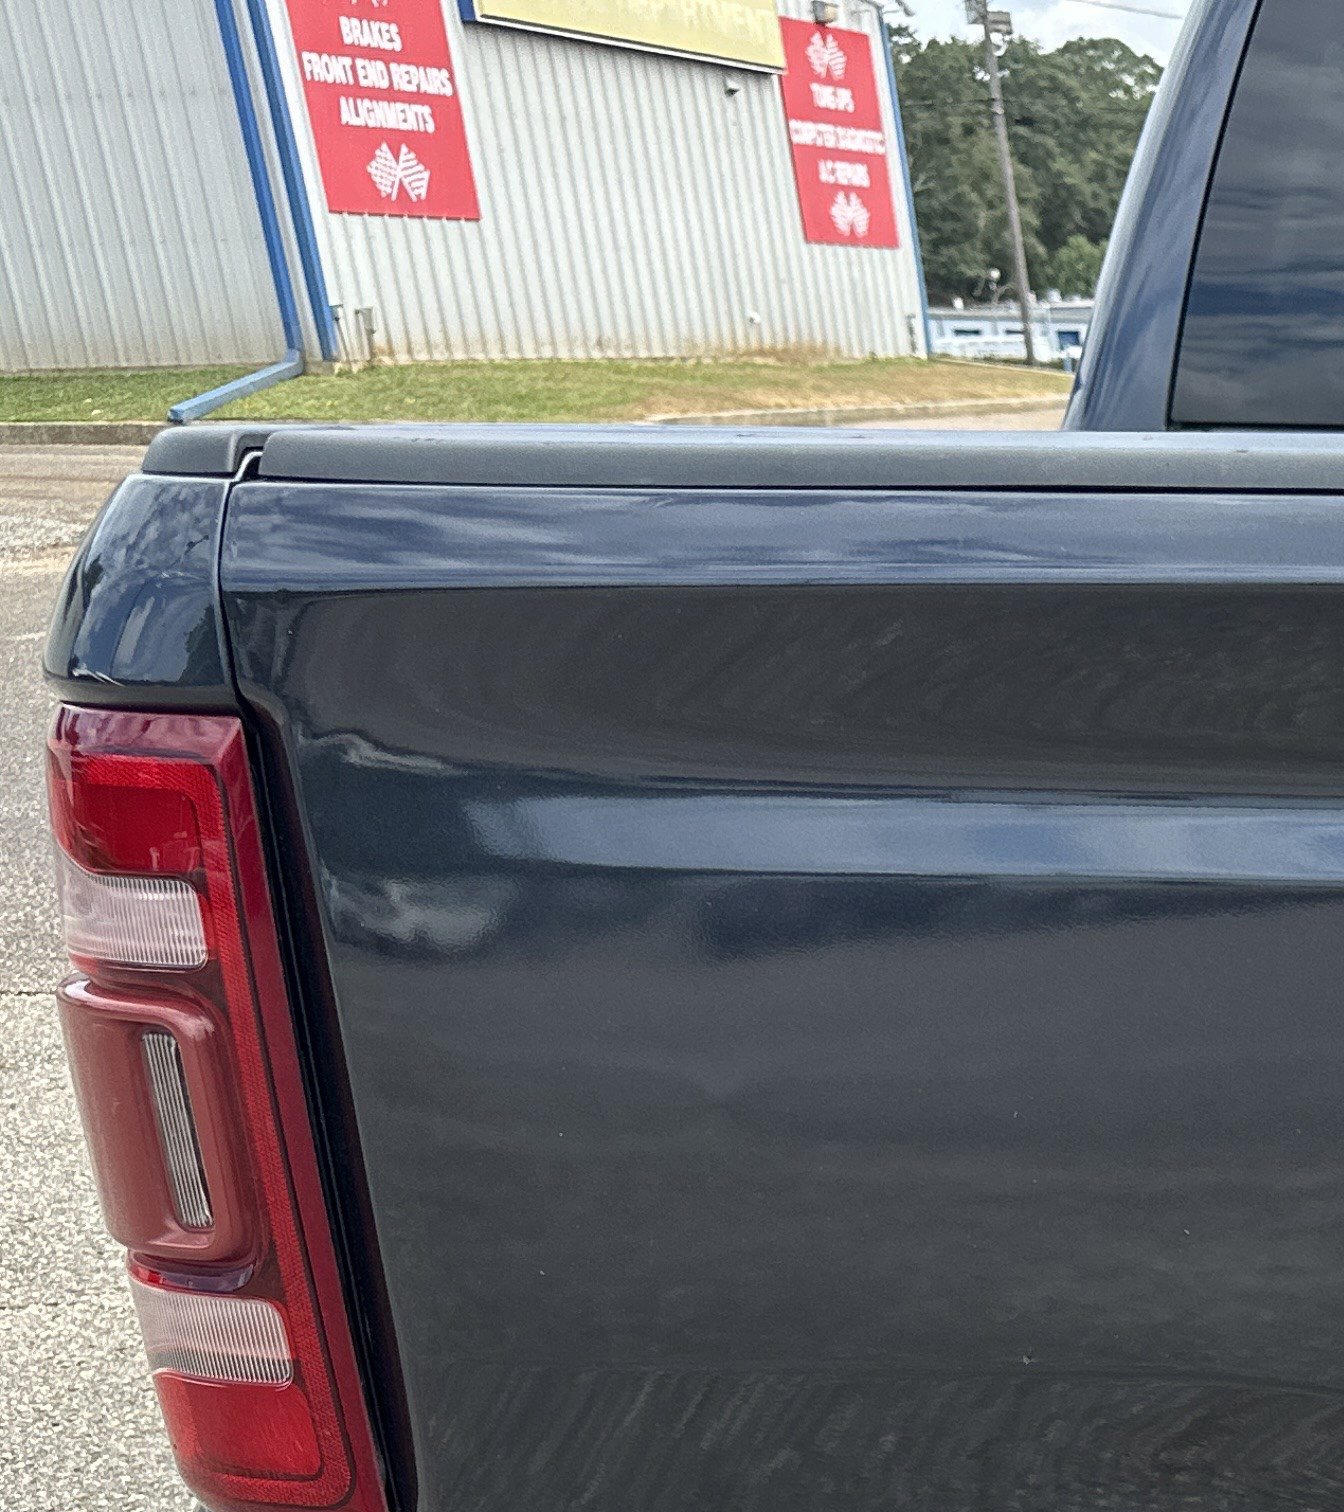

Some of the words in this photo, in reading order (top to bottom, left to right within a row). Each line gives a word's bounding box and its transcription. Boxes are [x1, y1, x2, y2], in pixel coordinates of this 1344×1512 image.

[339, 16, 402, 52] BRAKES
[302, 51, 354, 86] FRONT
[355, 58, 390, 90] END
[389, 62, 453, 97] REPAIRS
[339, 96, 435, 134] ALIGNMENTS
